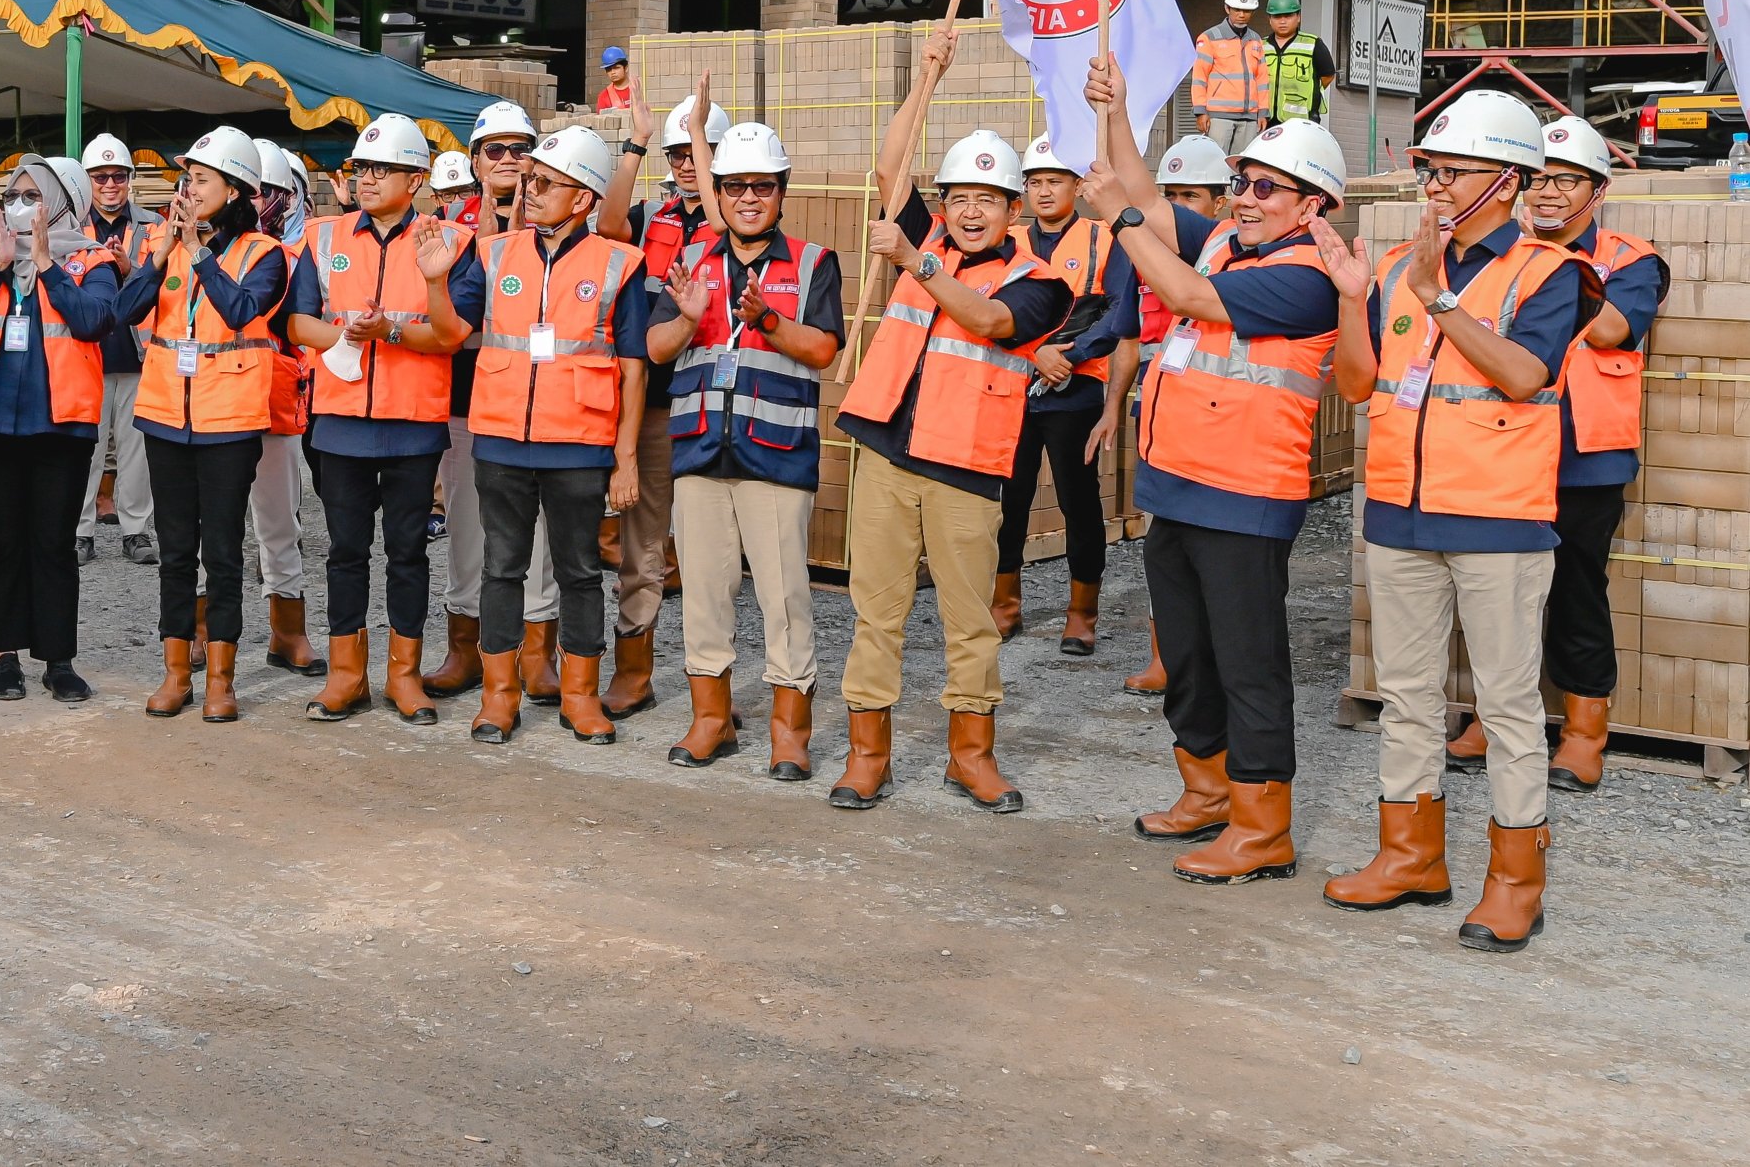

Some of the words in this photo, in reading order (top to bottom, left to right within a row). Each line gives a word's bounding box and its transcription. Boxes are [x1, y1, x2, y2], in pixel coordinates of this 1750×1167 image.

[1355, 40, 1416, 67] SEABLOCK
[1393, 67, 1415, 78] CENTER
[1485, 136, 1502, 144] TAMU
